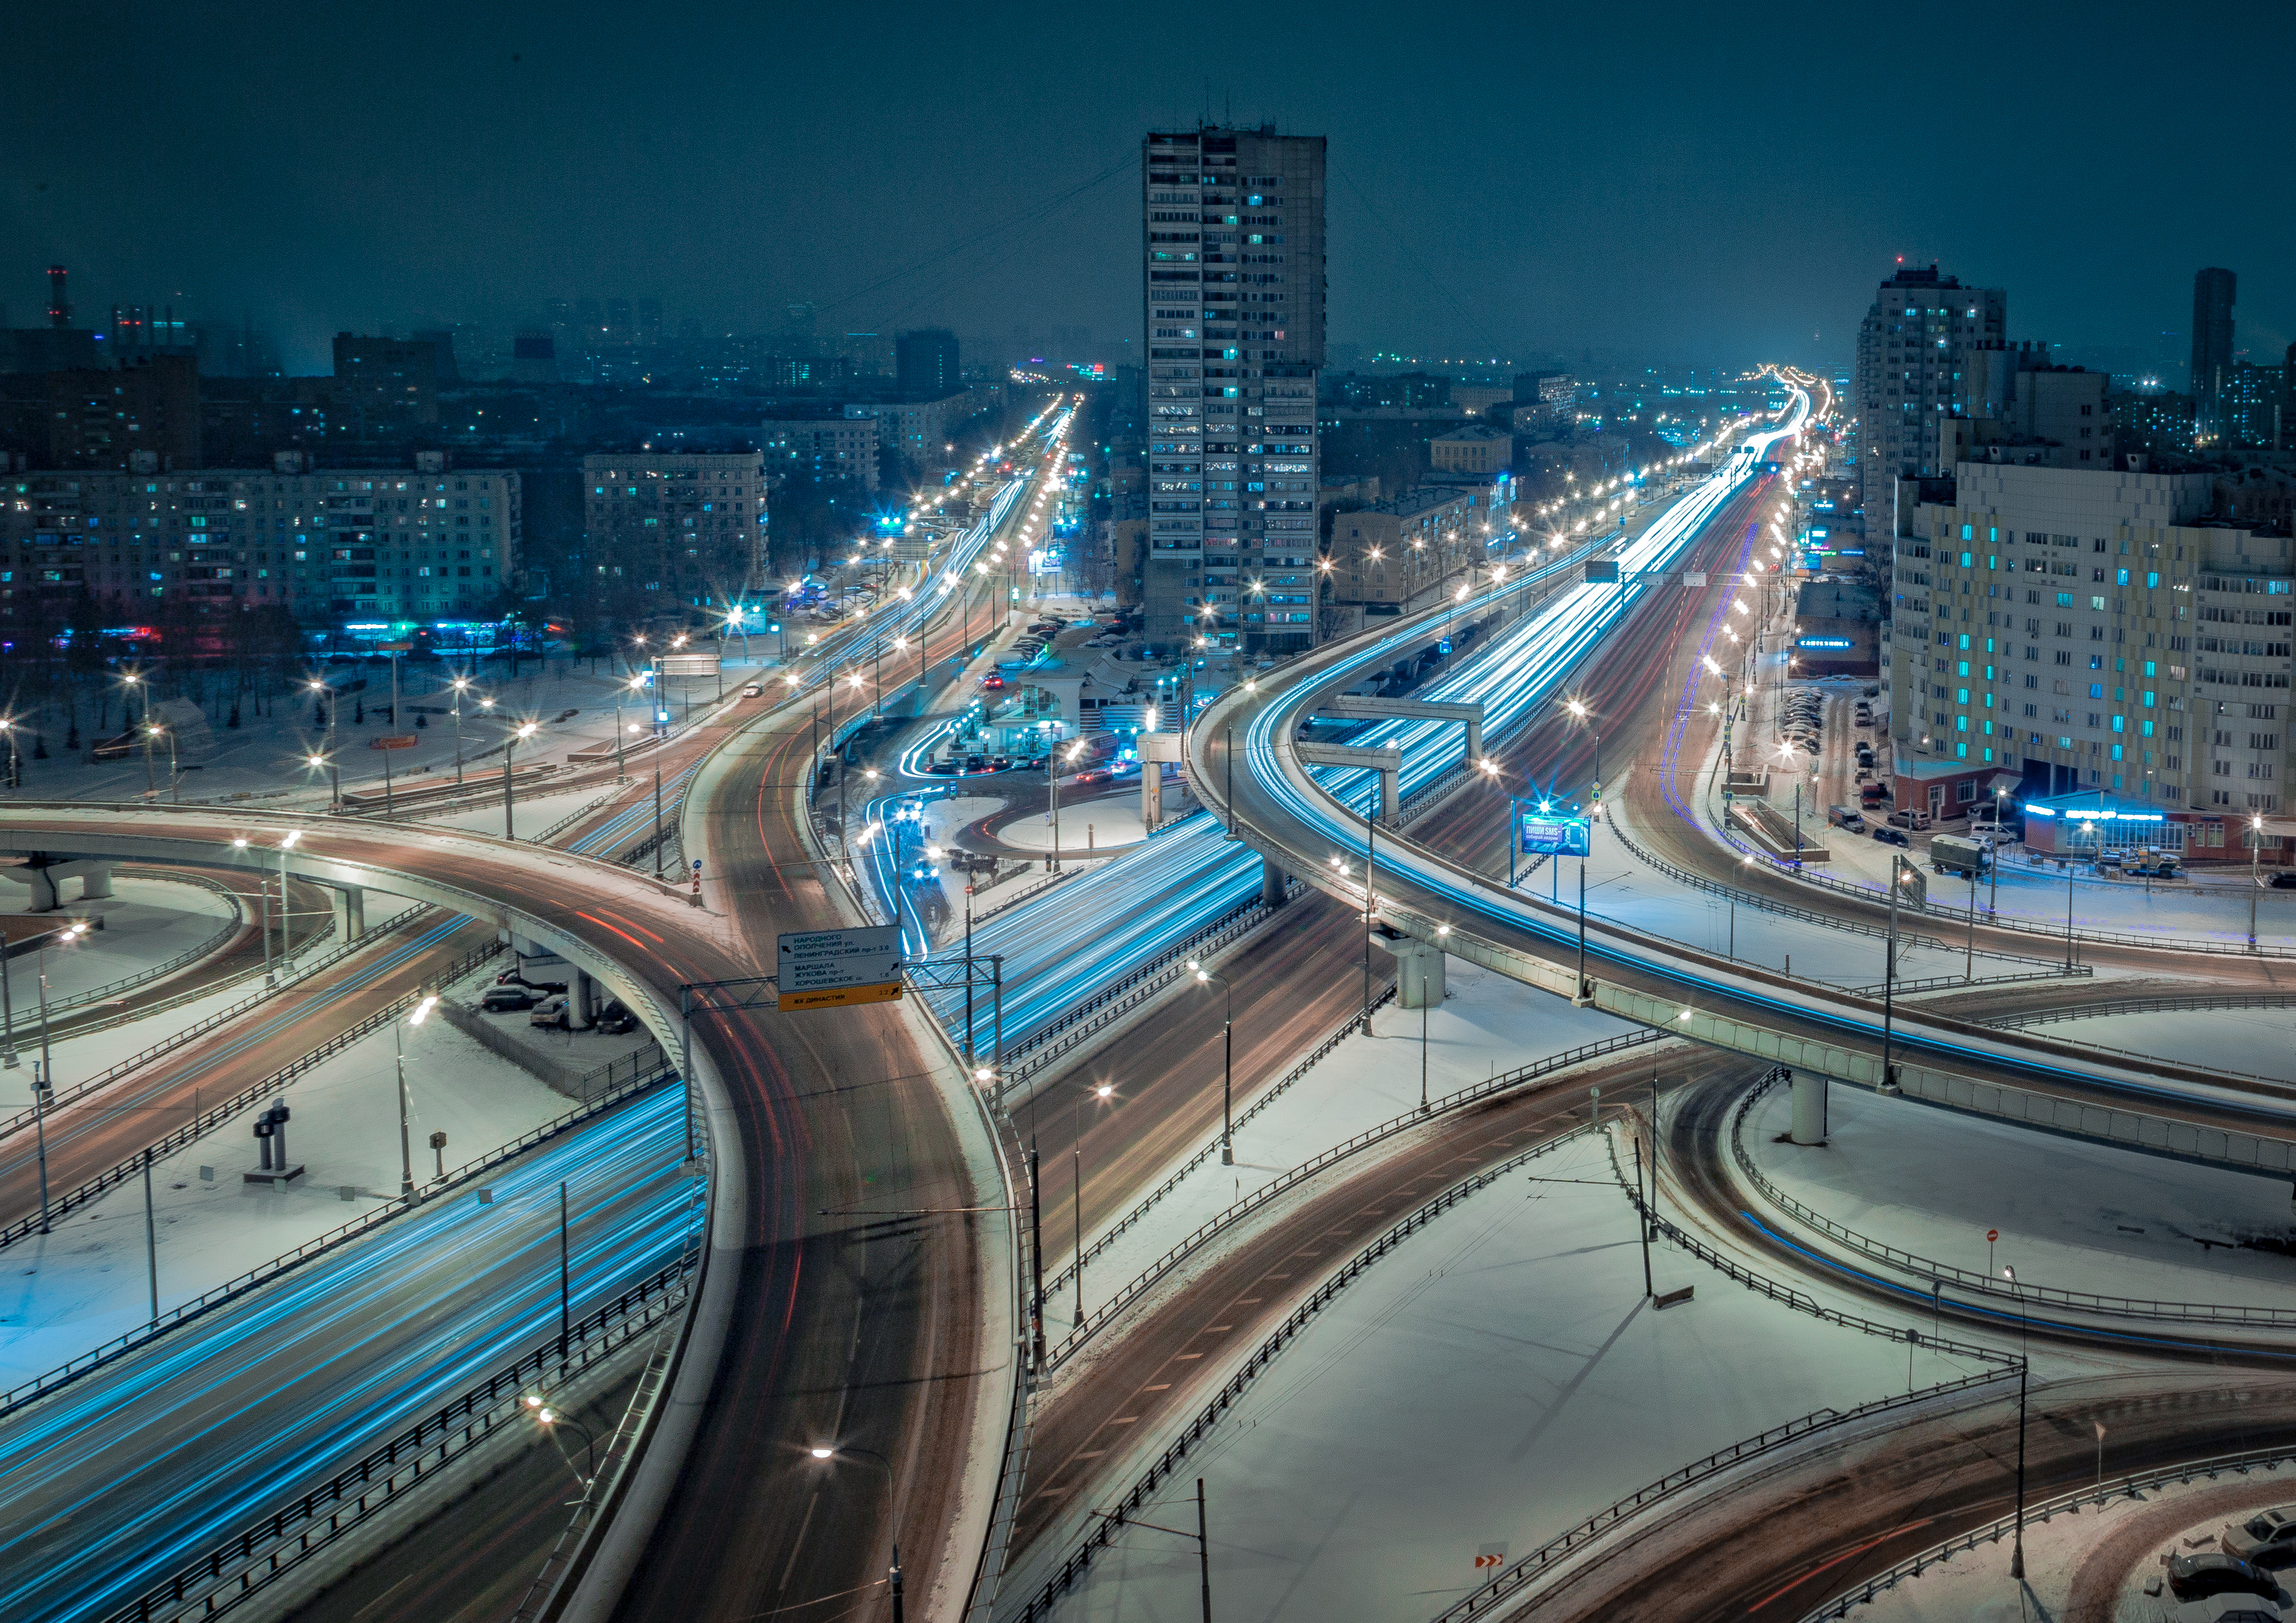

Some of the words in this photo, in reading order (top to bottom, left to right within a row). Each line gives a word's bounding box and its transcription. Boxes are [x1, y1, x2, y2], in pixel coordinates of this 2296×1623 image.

[1526, 826, 1545, 835] ПИШИ
[793, 934, 842, 944] НАРОДНОГО
[793, 940, 842, 950] ОПОЛЧЕНИЯ
[793, 947, 860, 959] ЛЕНИНГРАДСКИЙ
[794, 962, 835, 971] МАРШАЛА
[794, 969, 827, 978] ЖУКОВА
[795, 975, 854, 986] ХОРОШЕВСКОЕ
[806, 994, 845, 1003] ДИНАСТИЯ
